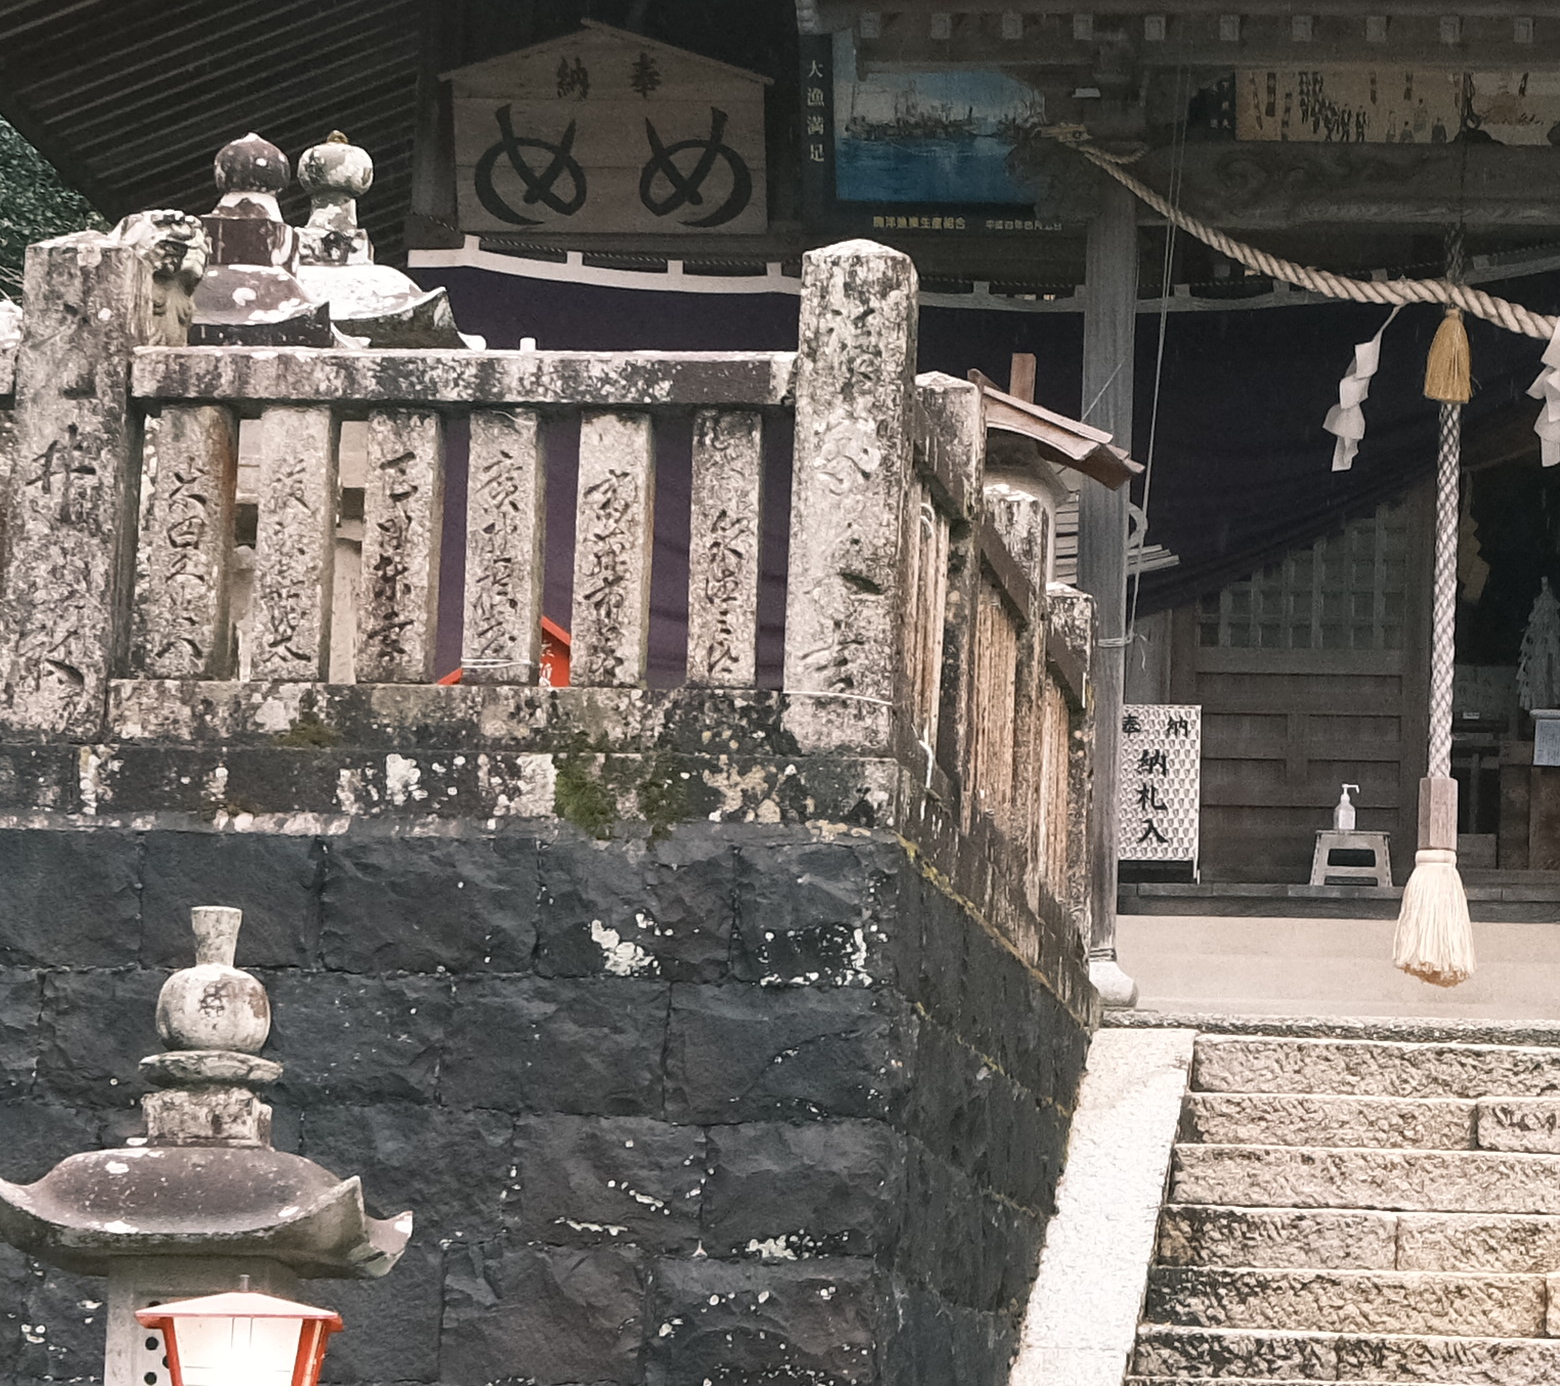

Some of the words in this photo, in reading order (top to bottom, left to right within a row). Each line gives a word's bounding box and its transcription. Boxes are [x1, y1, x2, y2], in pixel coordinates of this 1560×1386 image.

[555, 52, 663, 100] 奉納
[1135, 748, 1170, 844] 納札入
